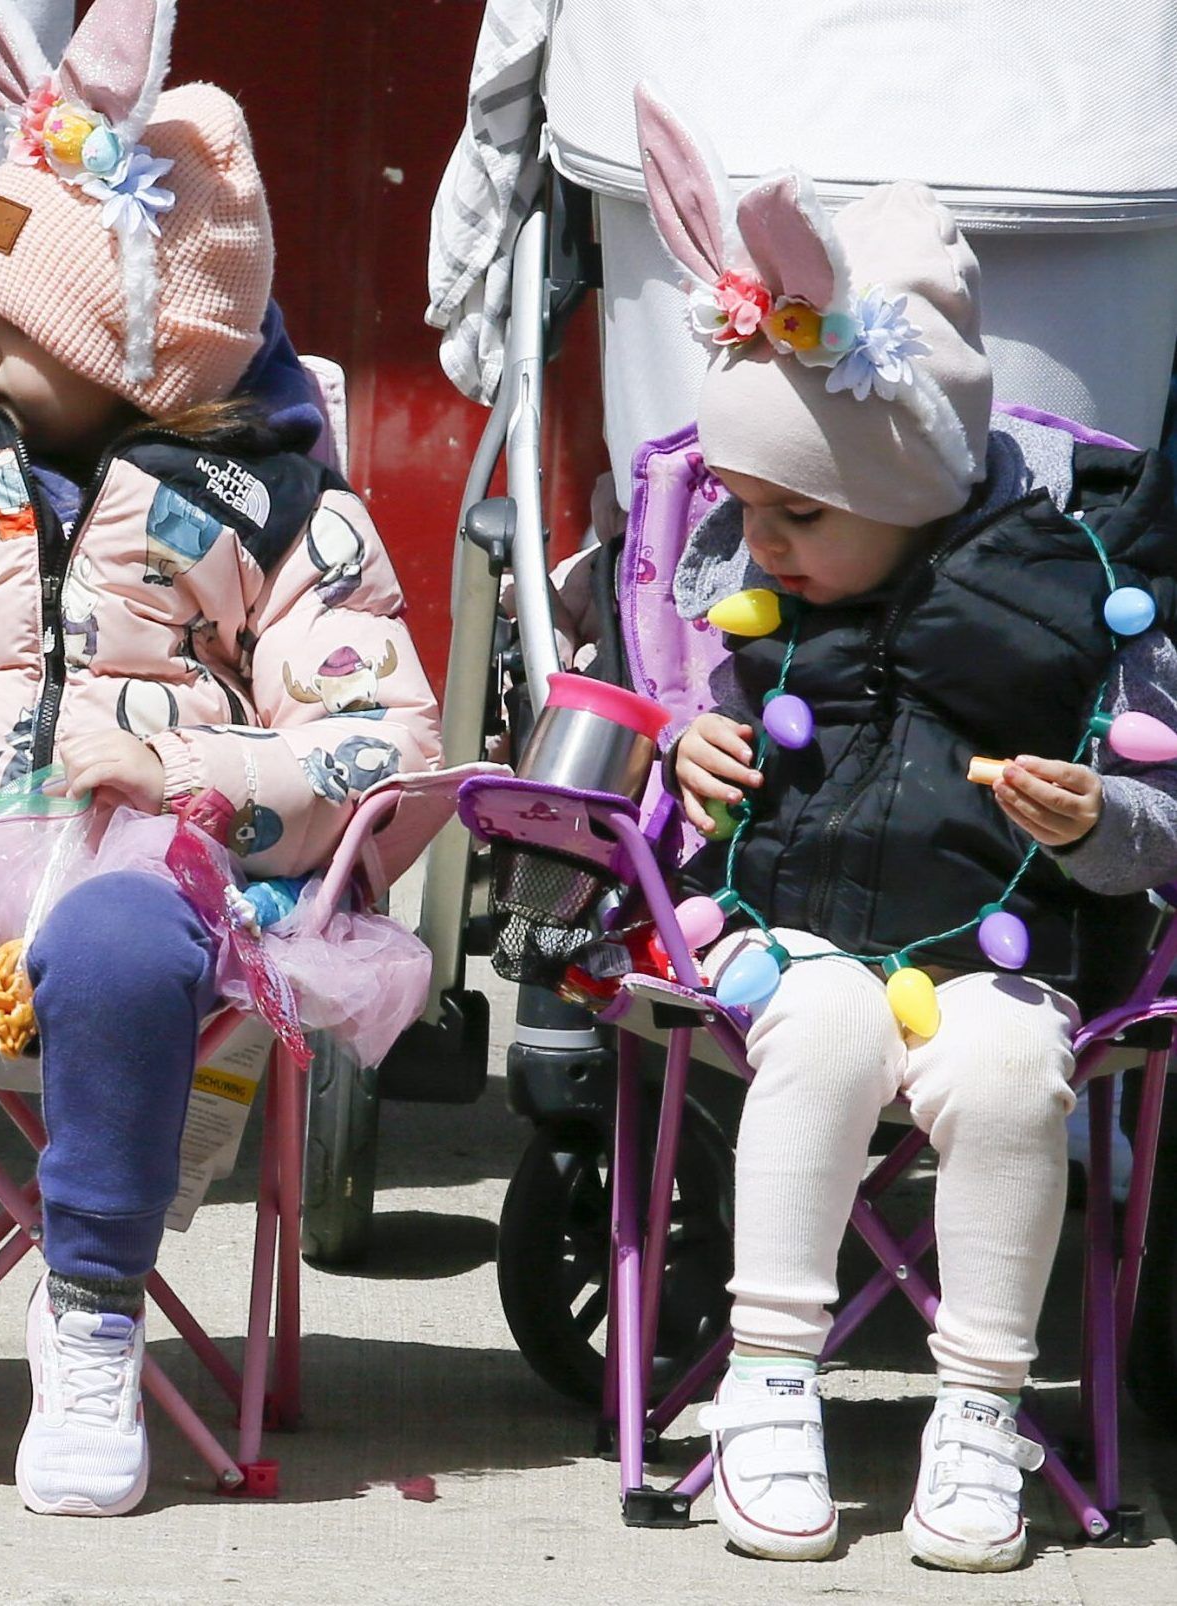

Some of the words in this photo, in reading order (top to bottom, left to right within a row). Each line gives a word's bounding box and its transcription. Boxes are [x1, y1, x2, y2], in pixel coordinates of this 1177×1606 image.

[196, 457, 249, 499] NORTH
[226, 460, 256, 487] THE
[206, 479, 245, 511] FACE
[194, 1073, 247, 1097] SCHUWING
